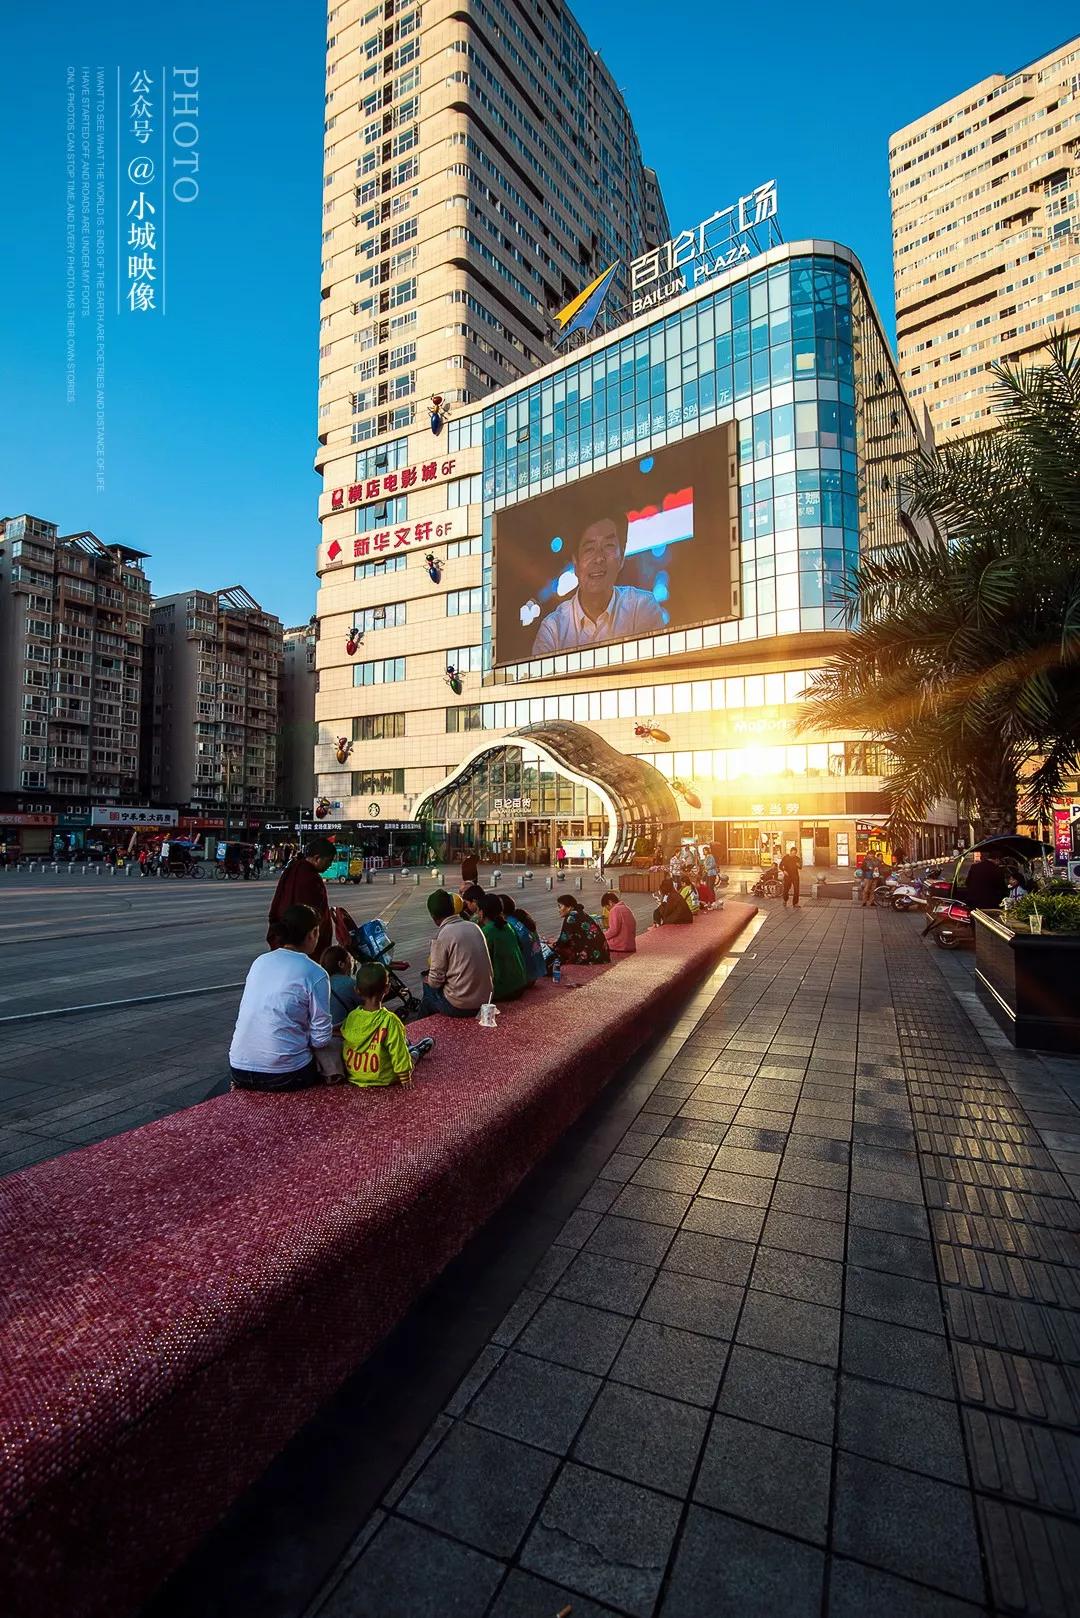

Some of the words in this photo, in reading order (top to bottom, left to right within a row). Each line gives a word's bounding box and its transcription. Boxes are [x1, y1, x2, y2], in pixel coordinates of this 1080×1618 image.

[630, 179, 777, 291] 百伦广场
[632, 274, 687, 315] BAILUN
[693, 243, 750, 281] PLAZA
[348, 461, 437, 505] 横店电影城
[441, 459, 456, 476] 6F
[353, 521, 433, 558] 新华文轩
[435, 522, 453, 538] 6F
[264, 823, 289, 831] Champion
[356, 822, 380, 830] Champion
[346, 1048, 380, 1073] 2010
